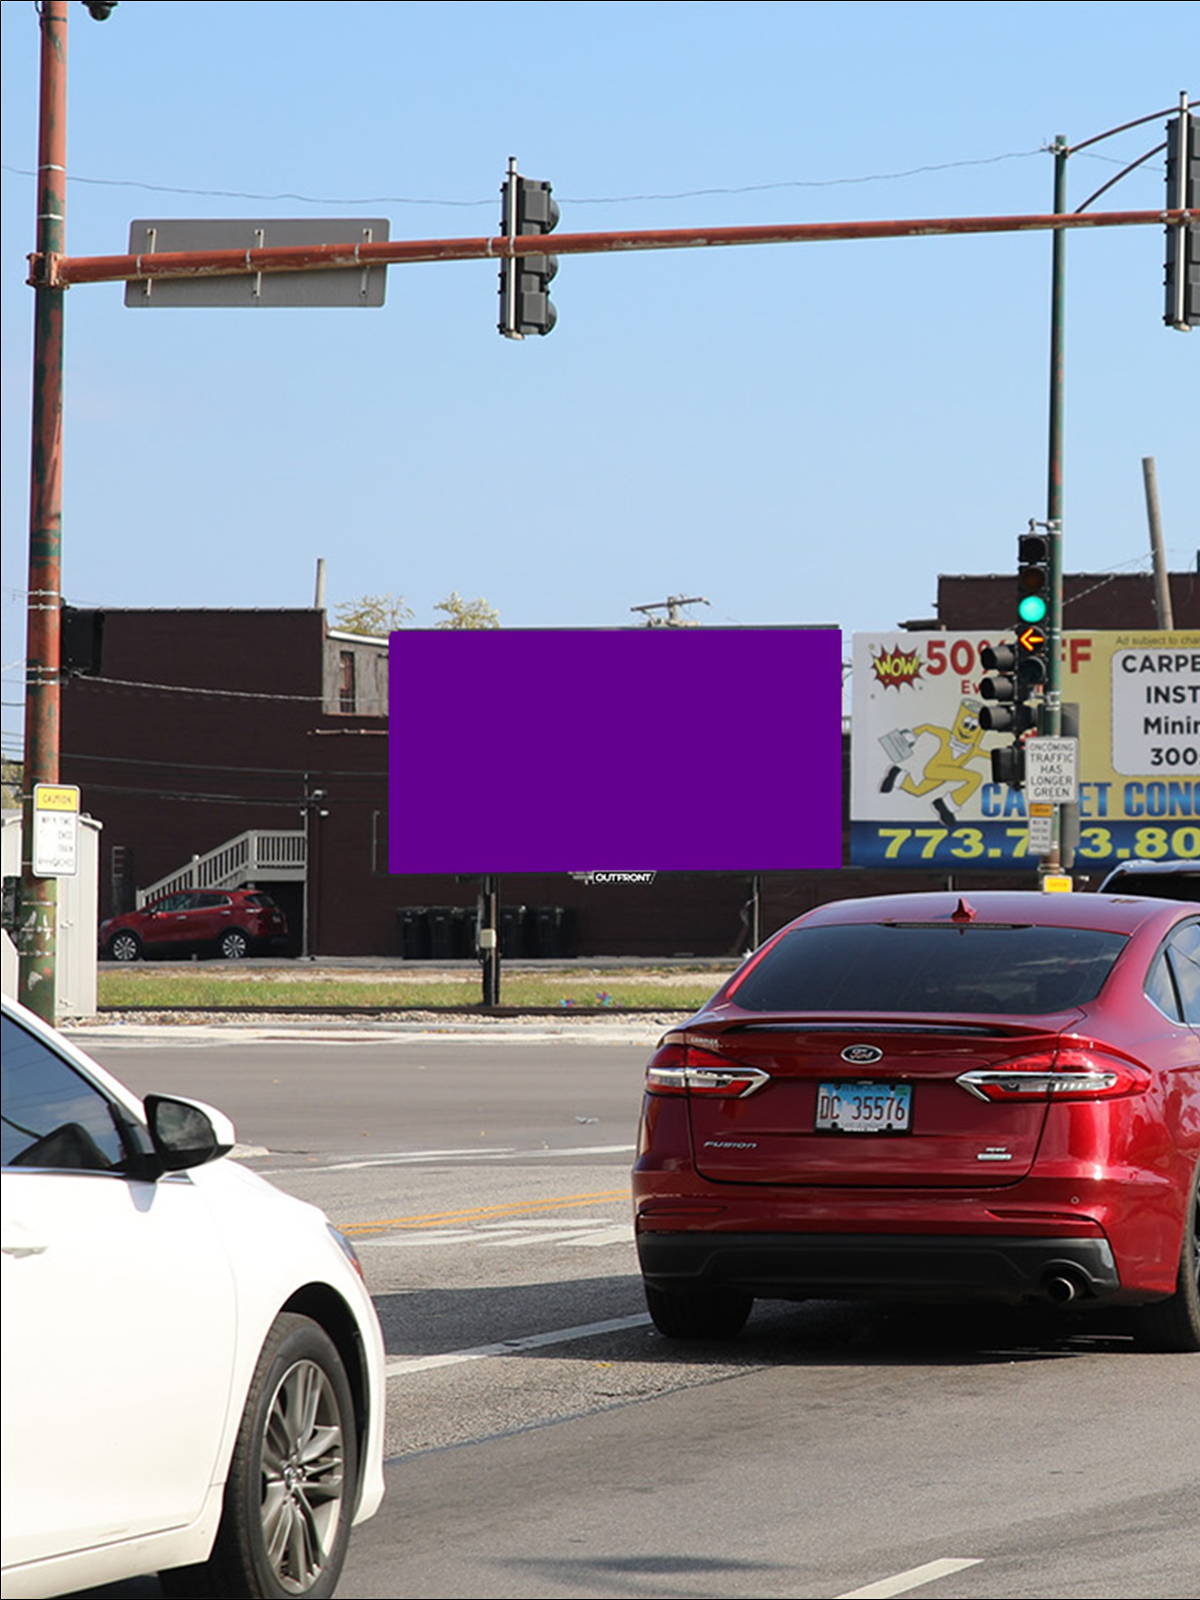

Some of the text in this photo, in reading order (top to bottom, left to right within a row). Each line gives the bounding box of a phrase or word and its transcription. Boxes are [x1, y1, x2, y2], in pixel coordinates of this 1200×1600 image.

[1116, 635, 1129, 645] Ad
[1132, 635, 1166, 647] subject
[1168, 636, 1178, 645] to
[874, 657, 920, 677] WOW!
[1030, 742, 1074, 751] ONCOMING
[1030, 753, 1074, 763] TRAFFIC
[1040, 764, 1063, 774] HAS
[1030, 775, 1072, 786] LONGER
[1033, 787, 1070, 798] GREEN
[981, 782, 1112, 818] CAET
[595, 873, 652, 883] OUTFRONT
[820, 1095, 906, 1121] DC 35576
